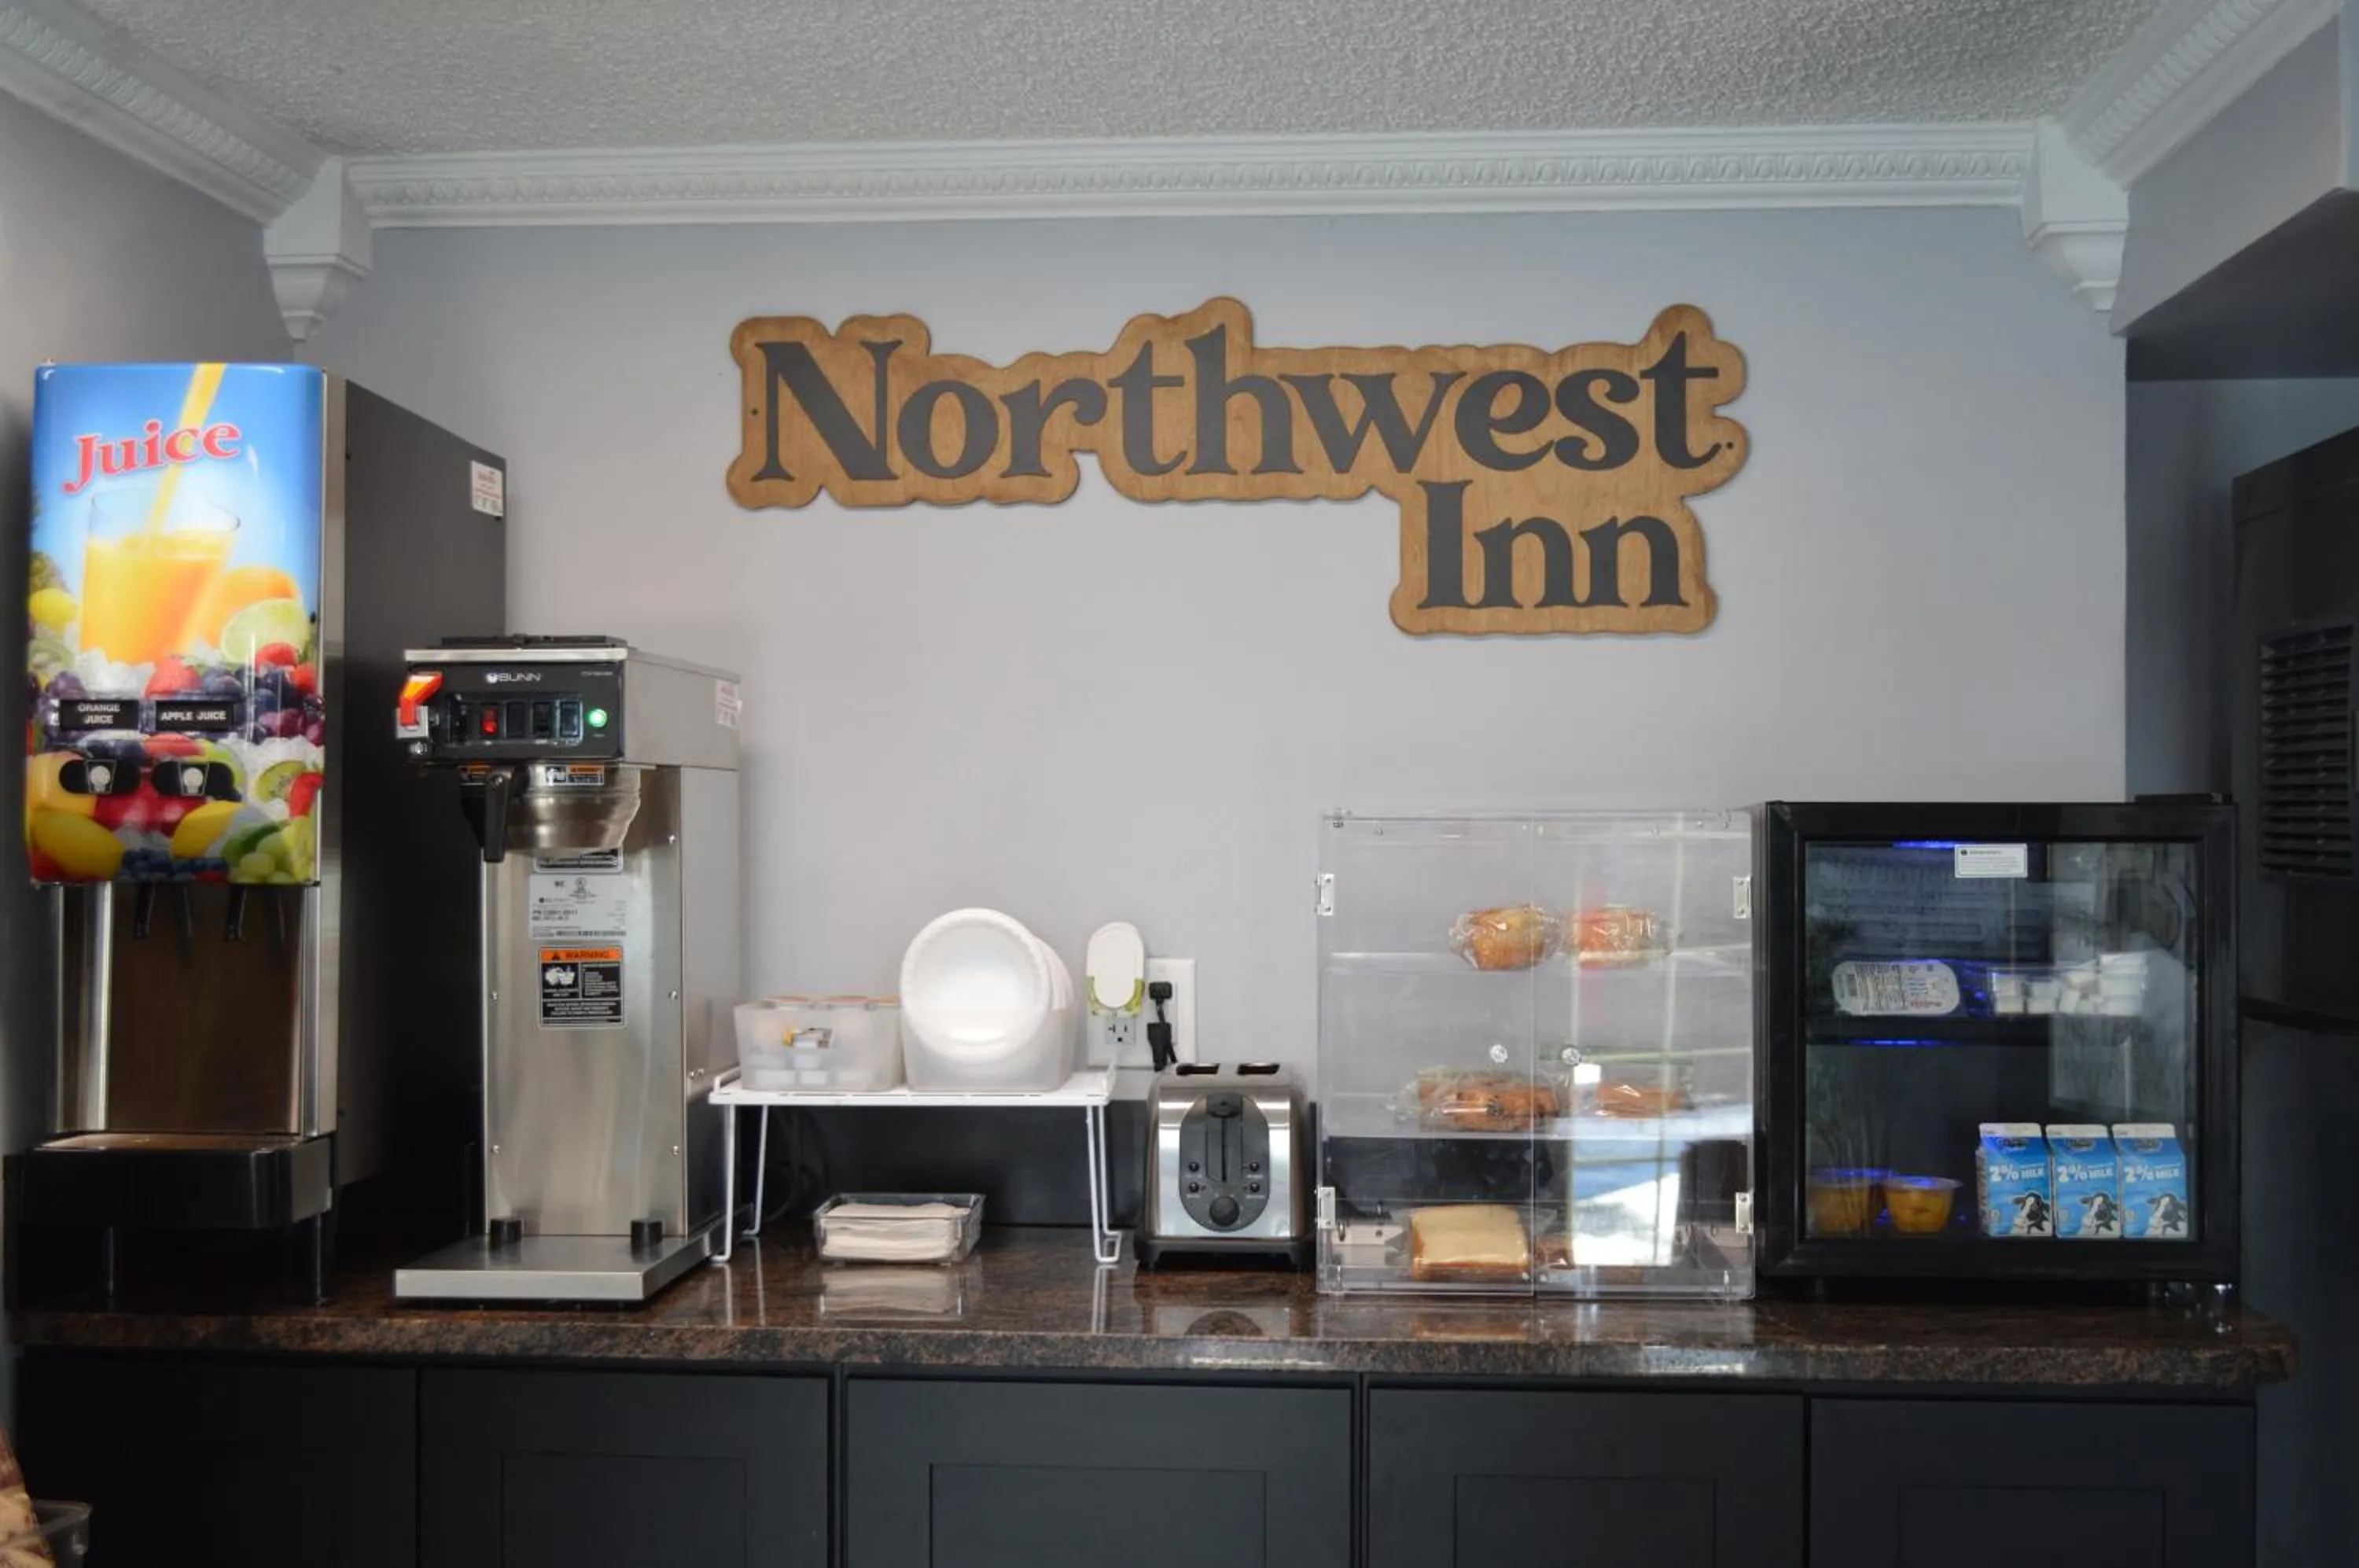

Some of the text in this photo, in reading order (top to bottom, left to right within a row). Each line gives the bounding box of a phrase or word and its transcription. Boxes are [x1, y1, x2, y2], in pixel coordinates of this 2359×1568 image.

[750, 323, 1722, 482] Northwest
[61, 420, 241, 495] Juice
[1416, 479, 1691, 609] Inn
[499, 672, 542, 682] BUNN
[78, 703, 120, 712] ORANGE
[160, 709, 227, 721] APPLE JUICE
[83, 714, 114, 724] JUICE
[565, 950, 610, 959] WARNING
[1989, 1164, 2019, 1183] 2%
[2020, 1167, 2044, 1180] MILK
[2057, 1163, 2088, 1183] 2%
[2089, 1167, 2114, 1180] MILK
[2125, 1164, 2181, 1183] 2% MILK
